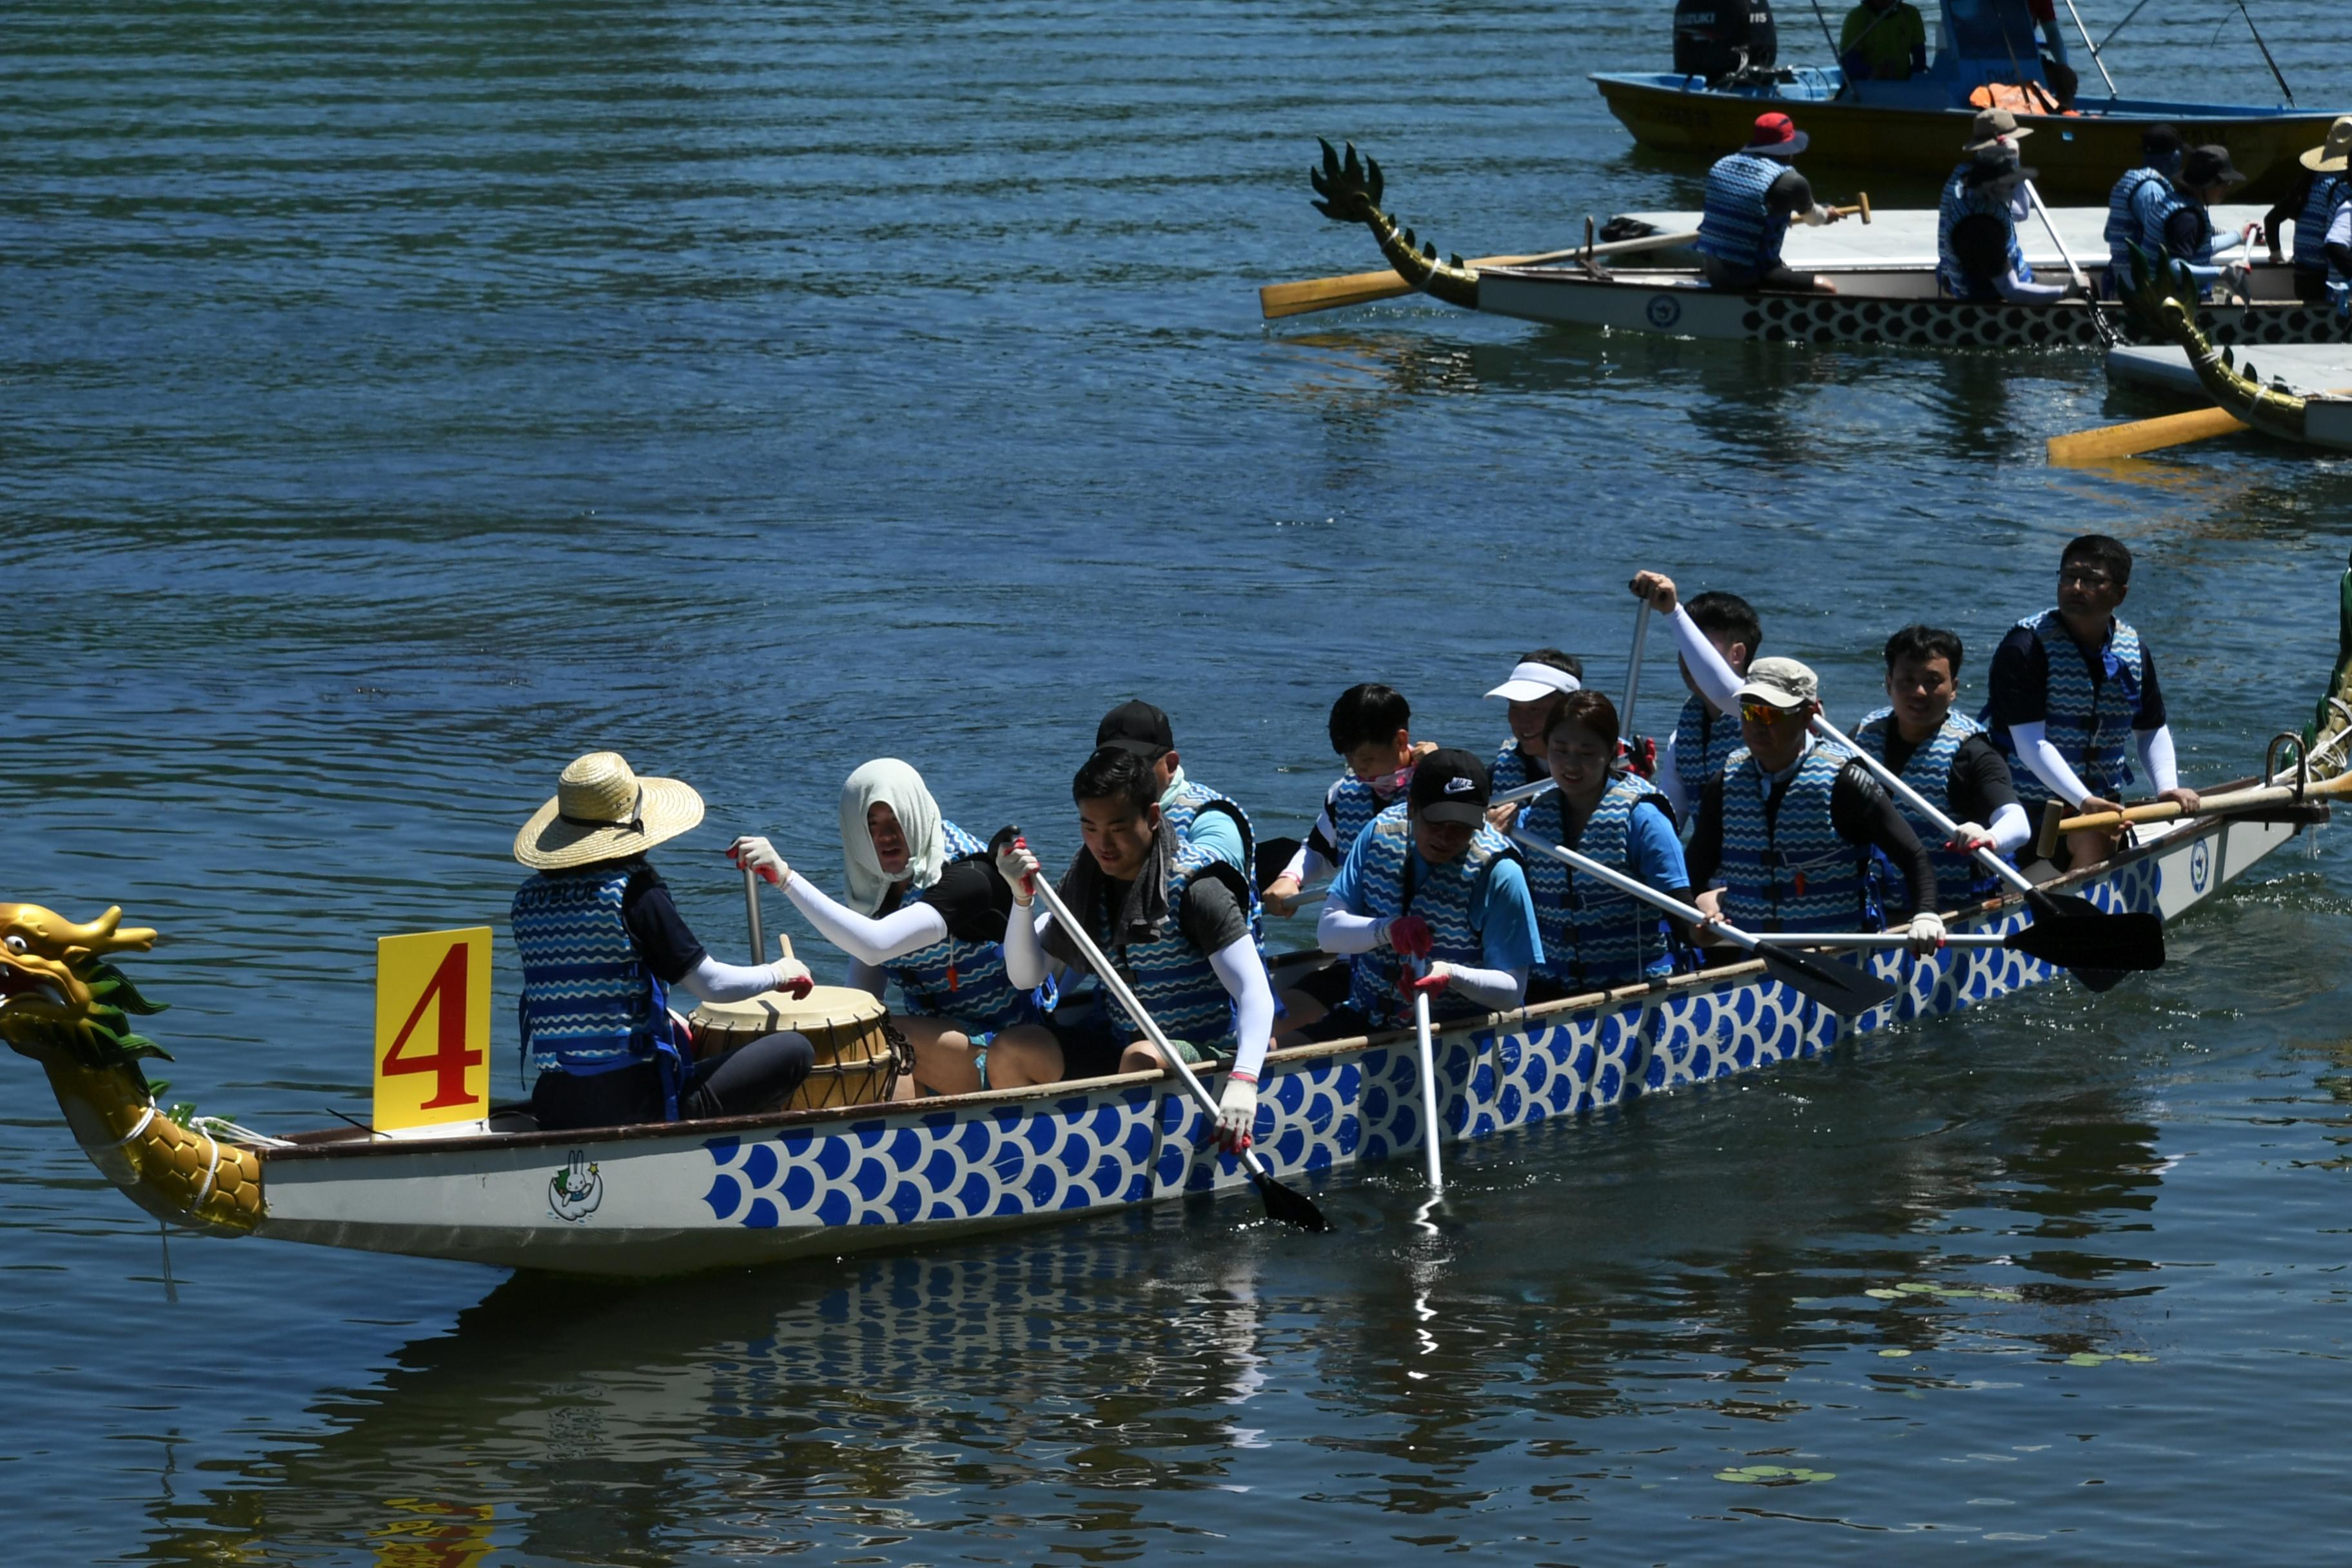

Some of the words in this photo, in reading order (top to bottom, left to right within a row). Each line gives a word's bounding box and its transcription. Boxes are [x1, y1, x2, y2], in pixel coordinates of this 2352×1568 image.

[1749, 12, 1767, 24] 115
[1450, 776, 1473, 788] NIKE
[382, 942, 483, 1110] 4
